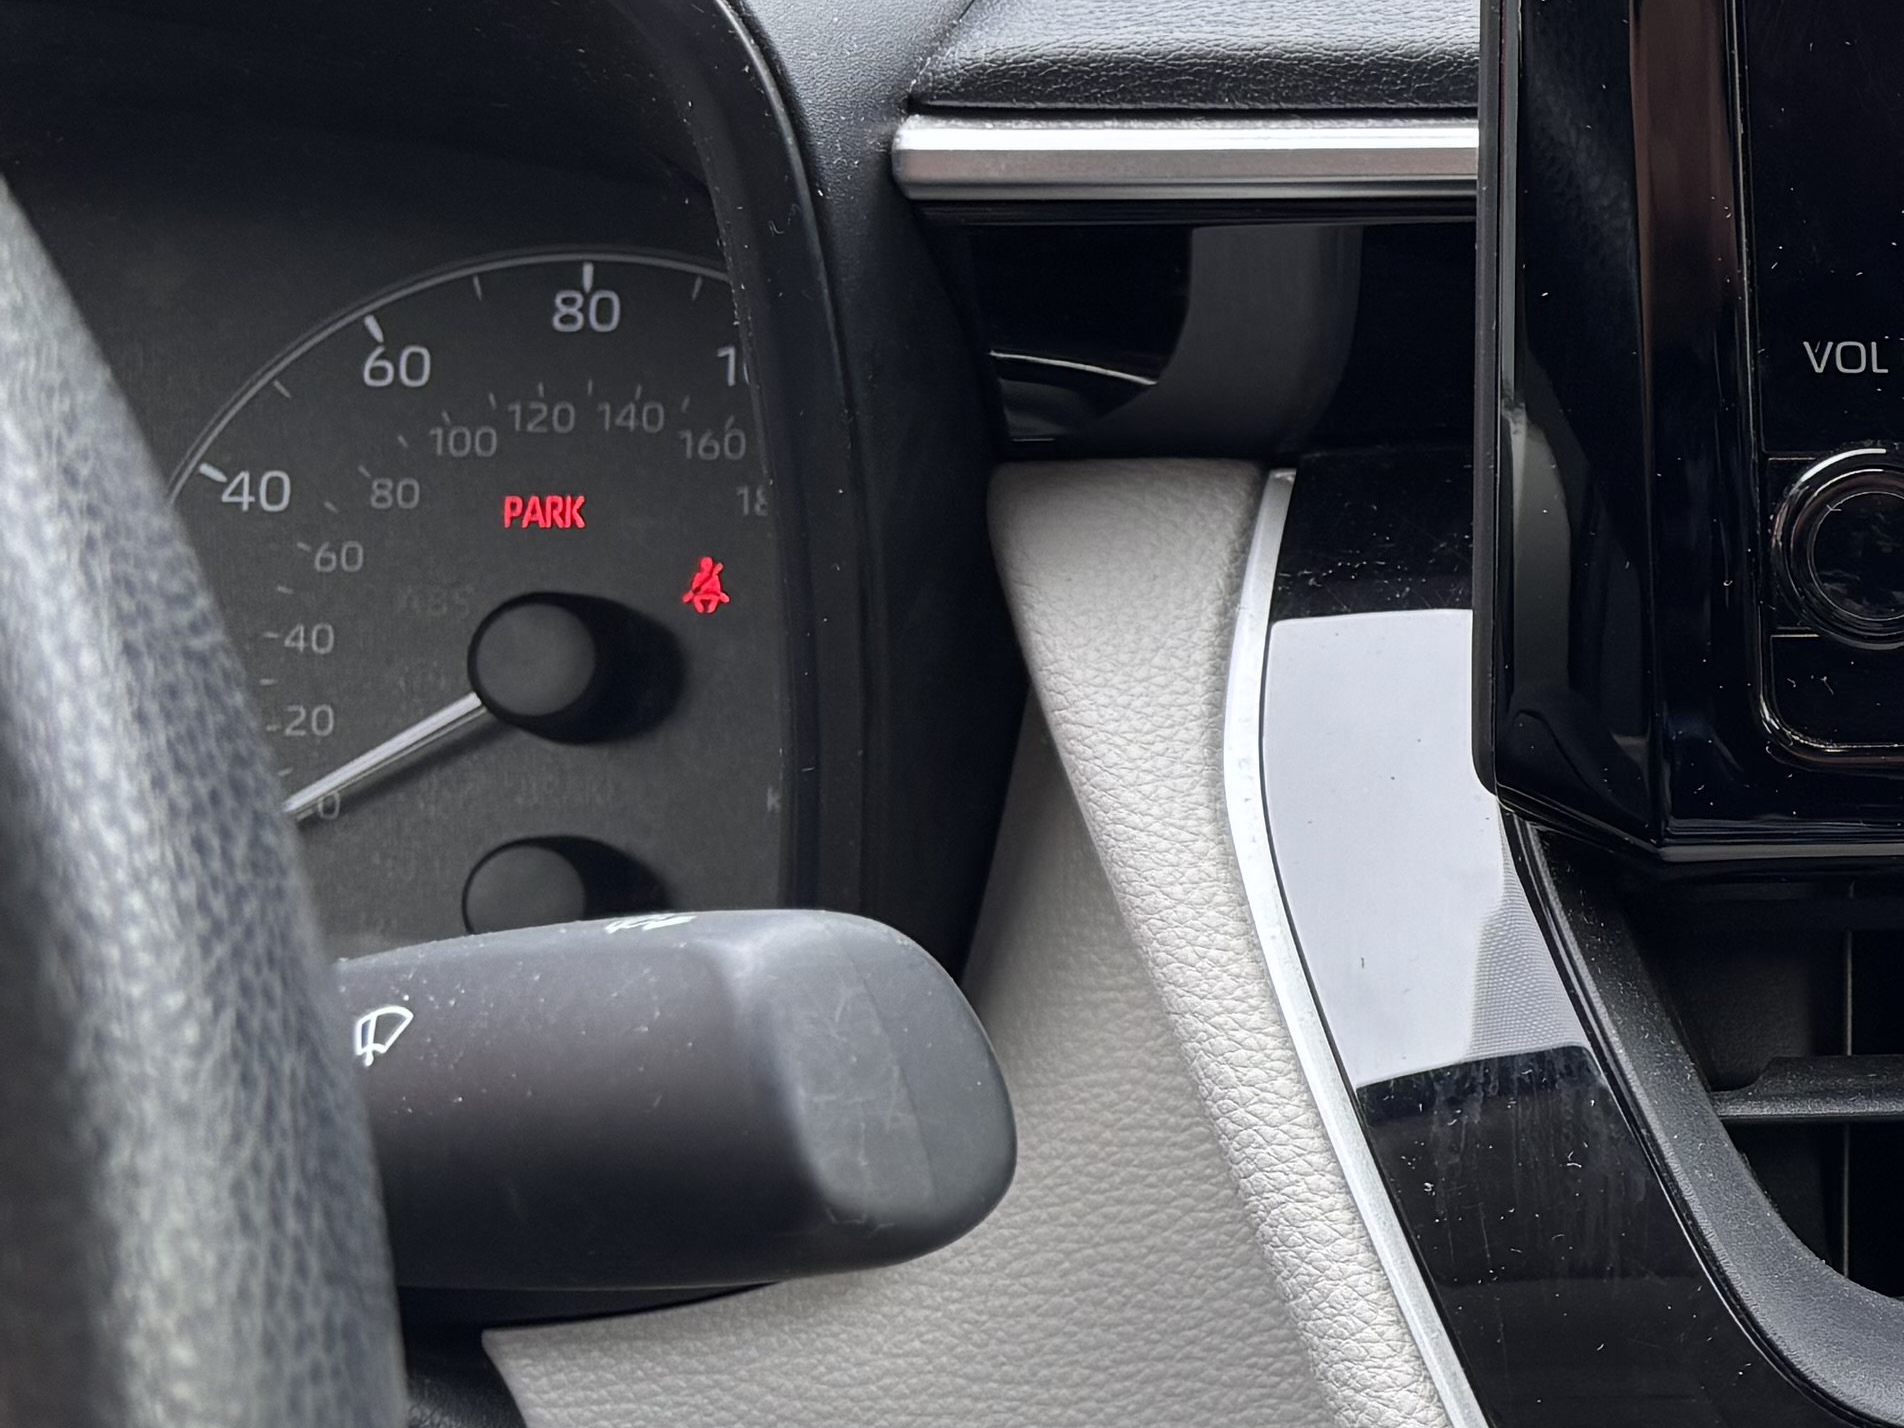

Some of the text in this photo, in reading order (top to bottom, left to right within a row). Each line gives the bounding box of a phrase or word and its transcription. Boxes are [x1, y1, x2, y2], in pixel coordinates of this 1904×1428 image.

[552, 289, 621, 333] 80
[362, 345, 431, 388] 60
[1803, 340, 1889, 374] VOL
[507, 401, 576, 433] 120
[597, 401, 665, 433] 140
[428, 426, 498, 458] 100
[677, 428, 746, 461] 160
[221, 470, 292, 513] 40
[369, 477, 420, 509] 80
[504, 495, 587, 529] PARK
[314, 540, 364, 573] 60
[284, 623, 335, 655] 40
[284, 703, 335, 737] 20
